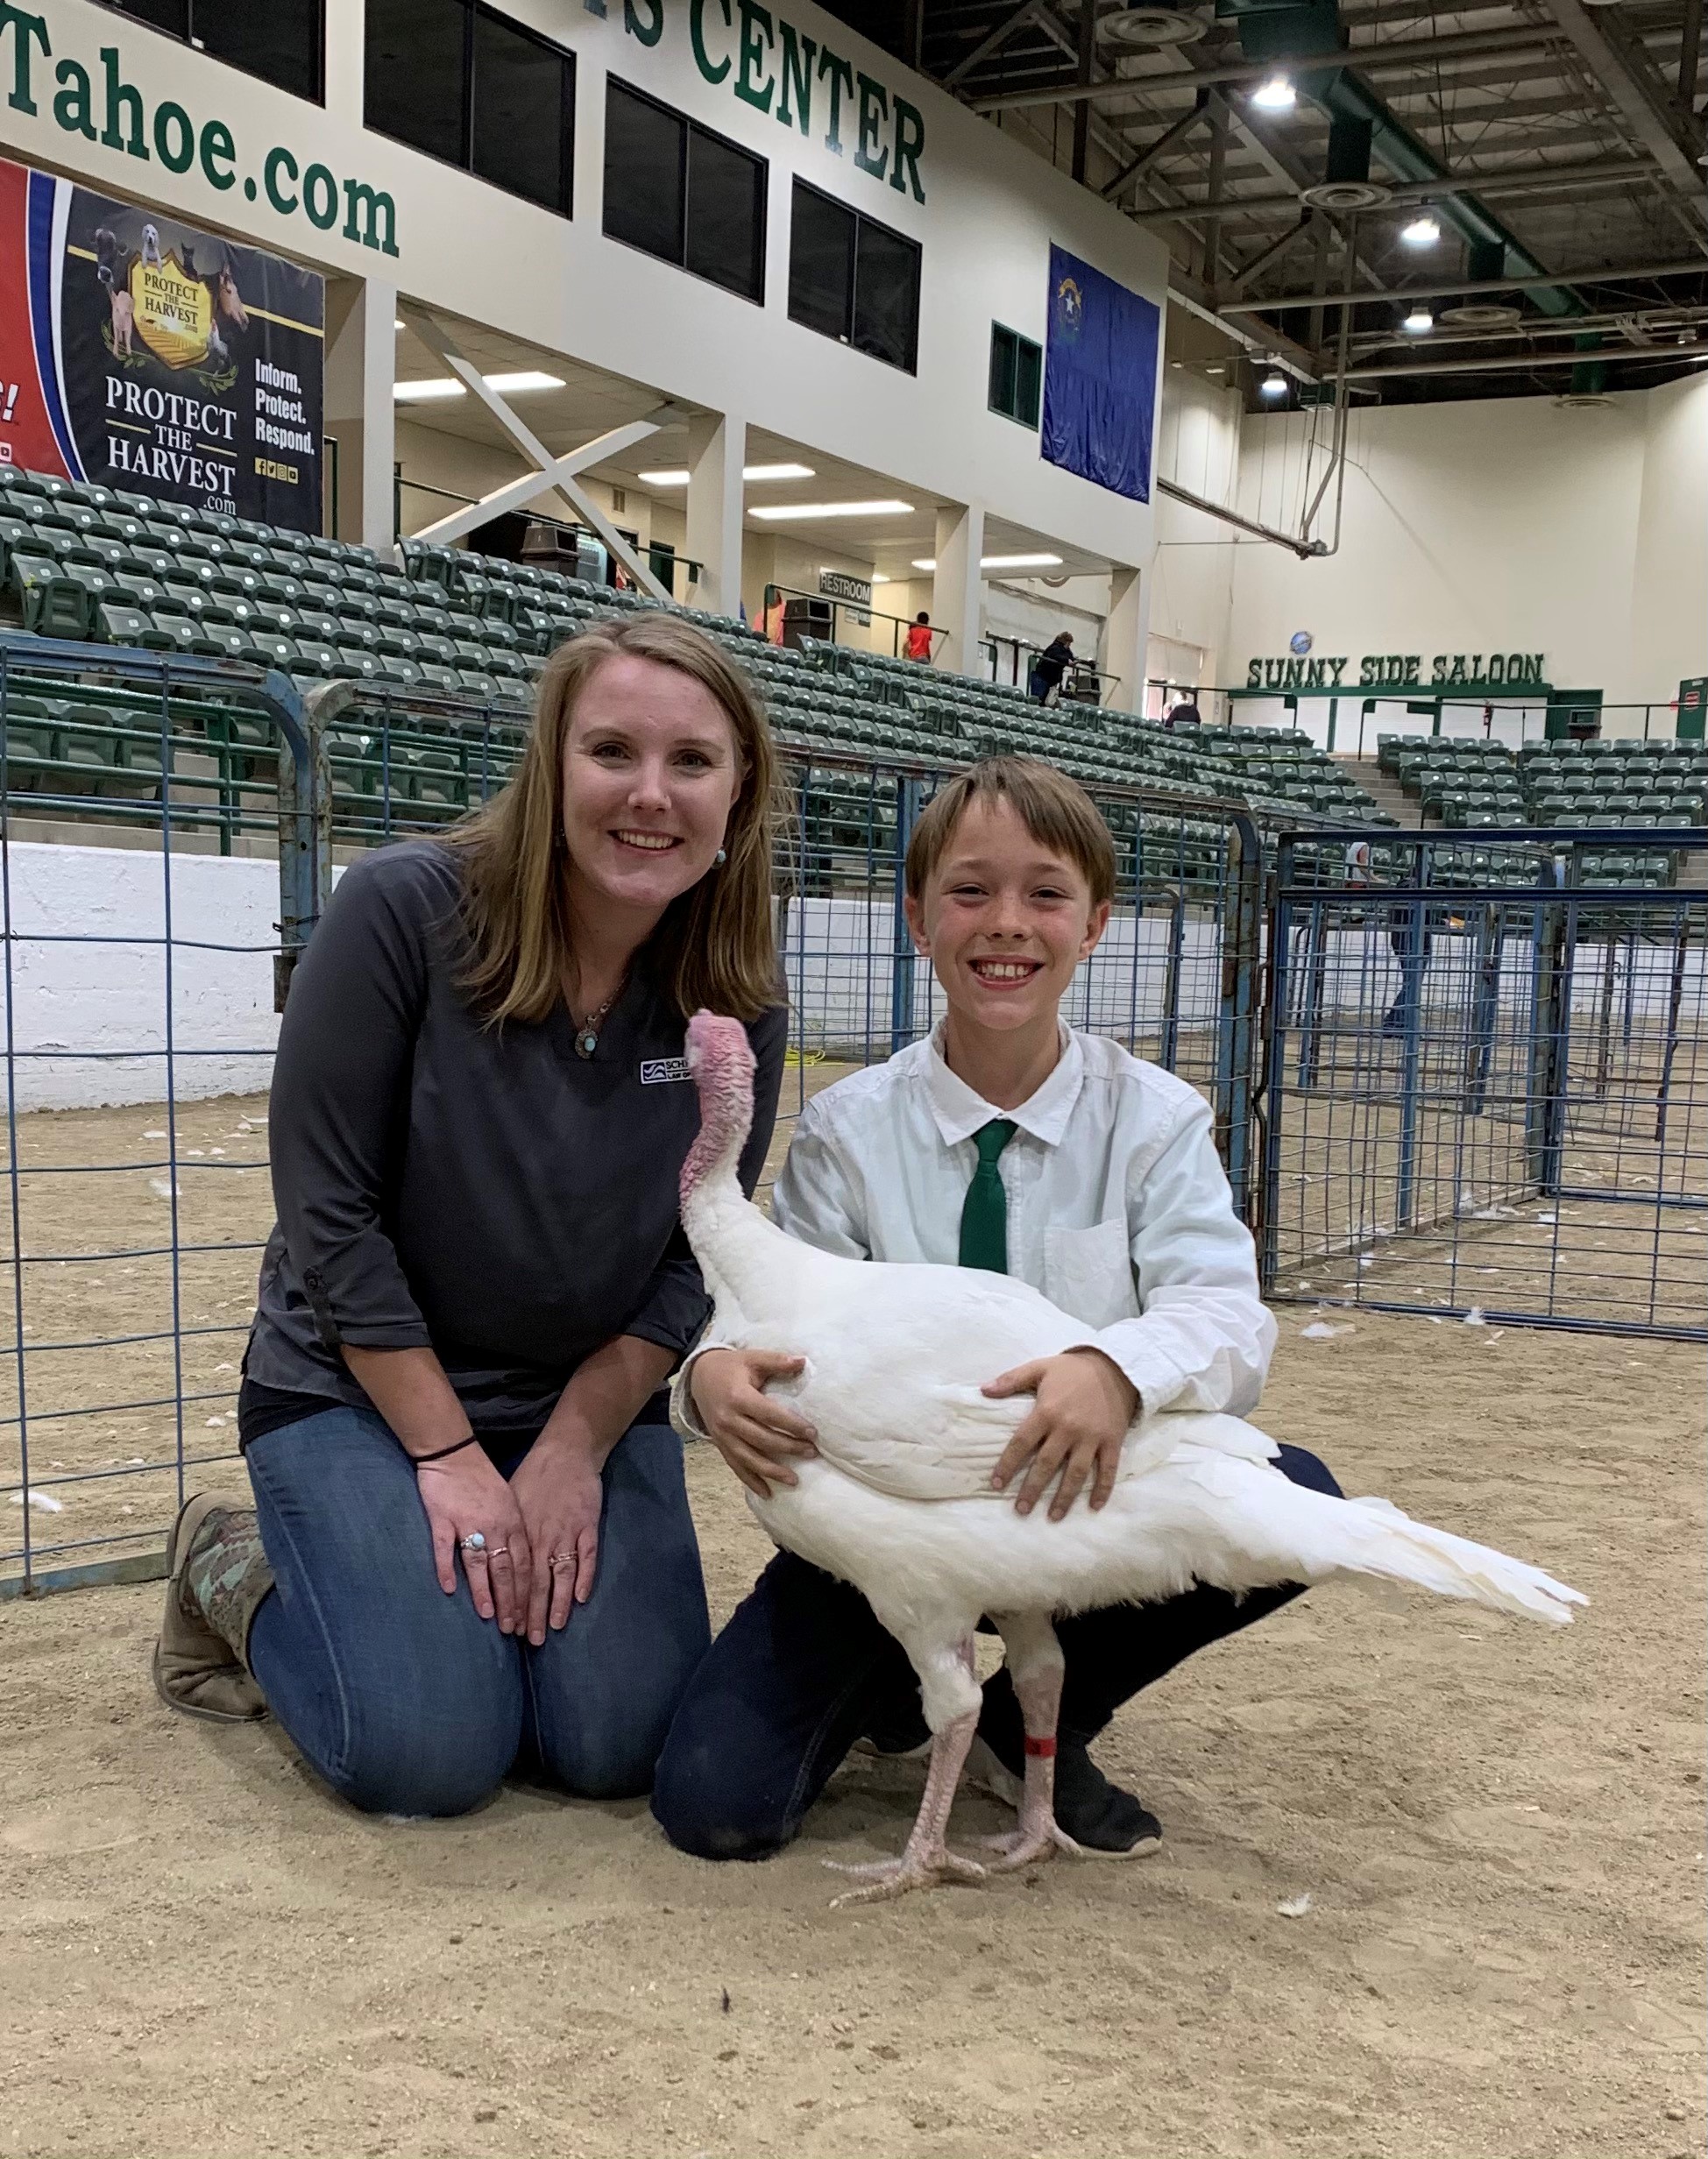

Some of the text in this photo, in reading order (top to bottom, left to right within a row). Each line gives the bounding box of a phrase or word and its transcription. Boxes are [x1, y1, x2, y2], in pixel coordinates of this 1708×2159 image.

[690, 0, 925, 205] CENTER
[0, 0, 400, 258] Tahoe.com
[145, 273, 198, 301] PROTECT
[164, 294, 180, 306] THE
[145, 297, 198, 325] HARVEST
[255, 357, 302, 394] Inform.
[105, 375, 237, 440] PROTECT
[255, 387, 306, 424] Protect.
[154, 423, 193, 452] THE
[255, 416, 315, 456] Respond.
[107, 435, 236, 496] HARVEST
[202, 495, 237, 516] .com
[820, 572, 871, 602] RESTROOM
[1247, 653, 1545, 688] SUNNY SIDE SALOON
[666, 1059, 689, 1069] SCH
